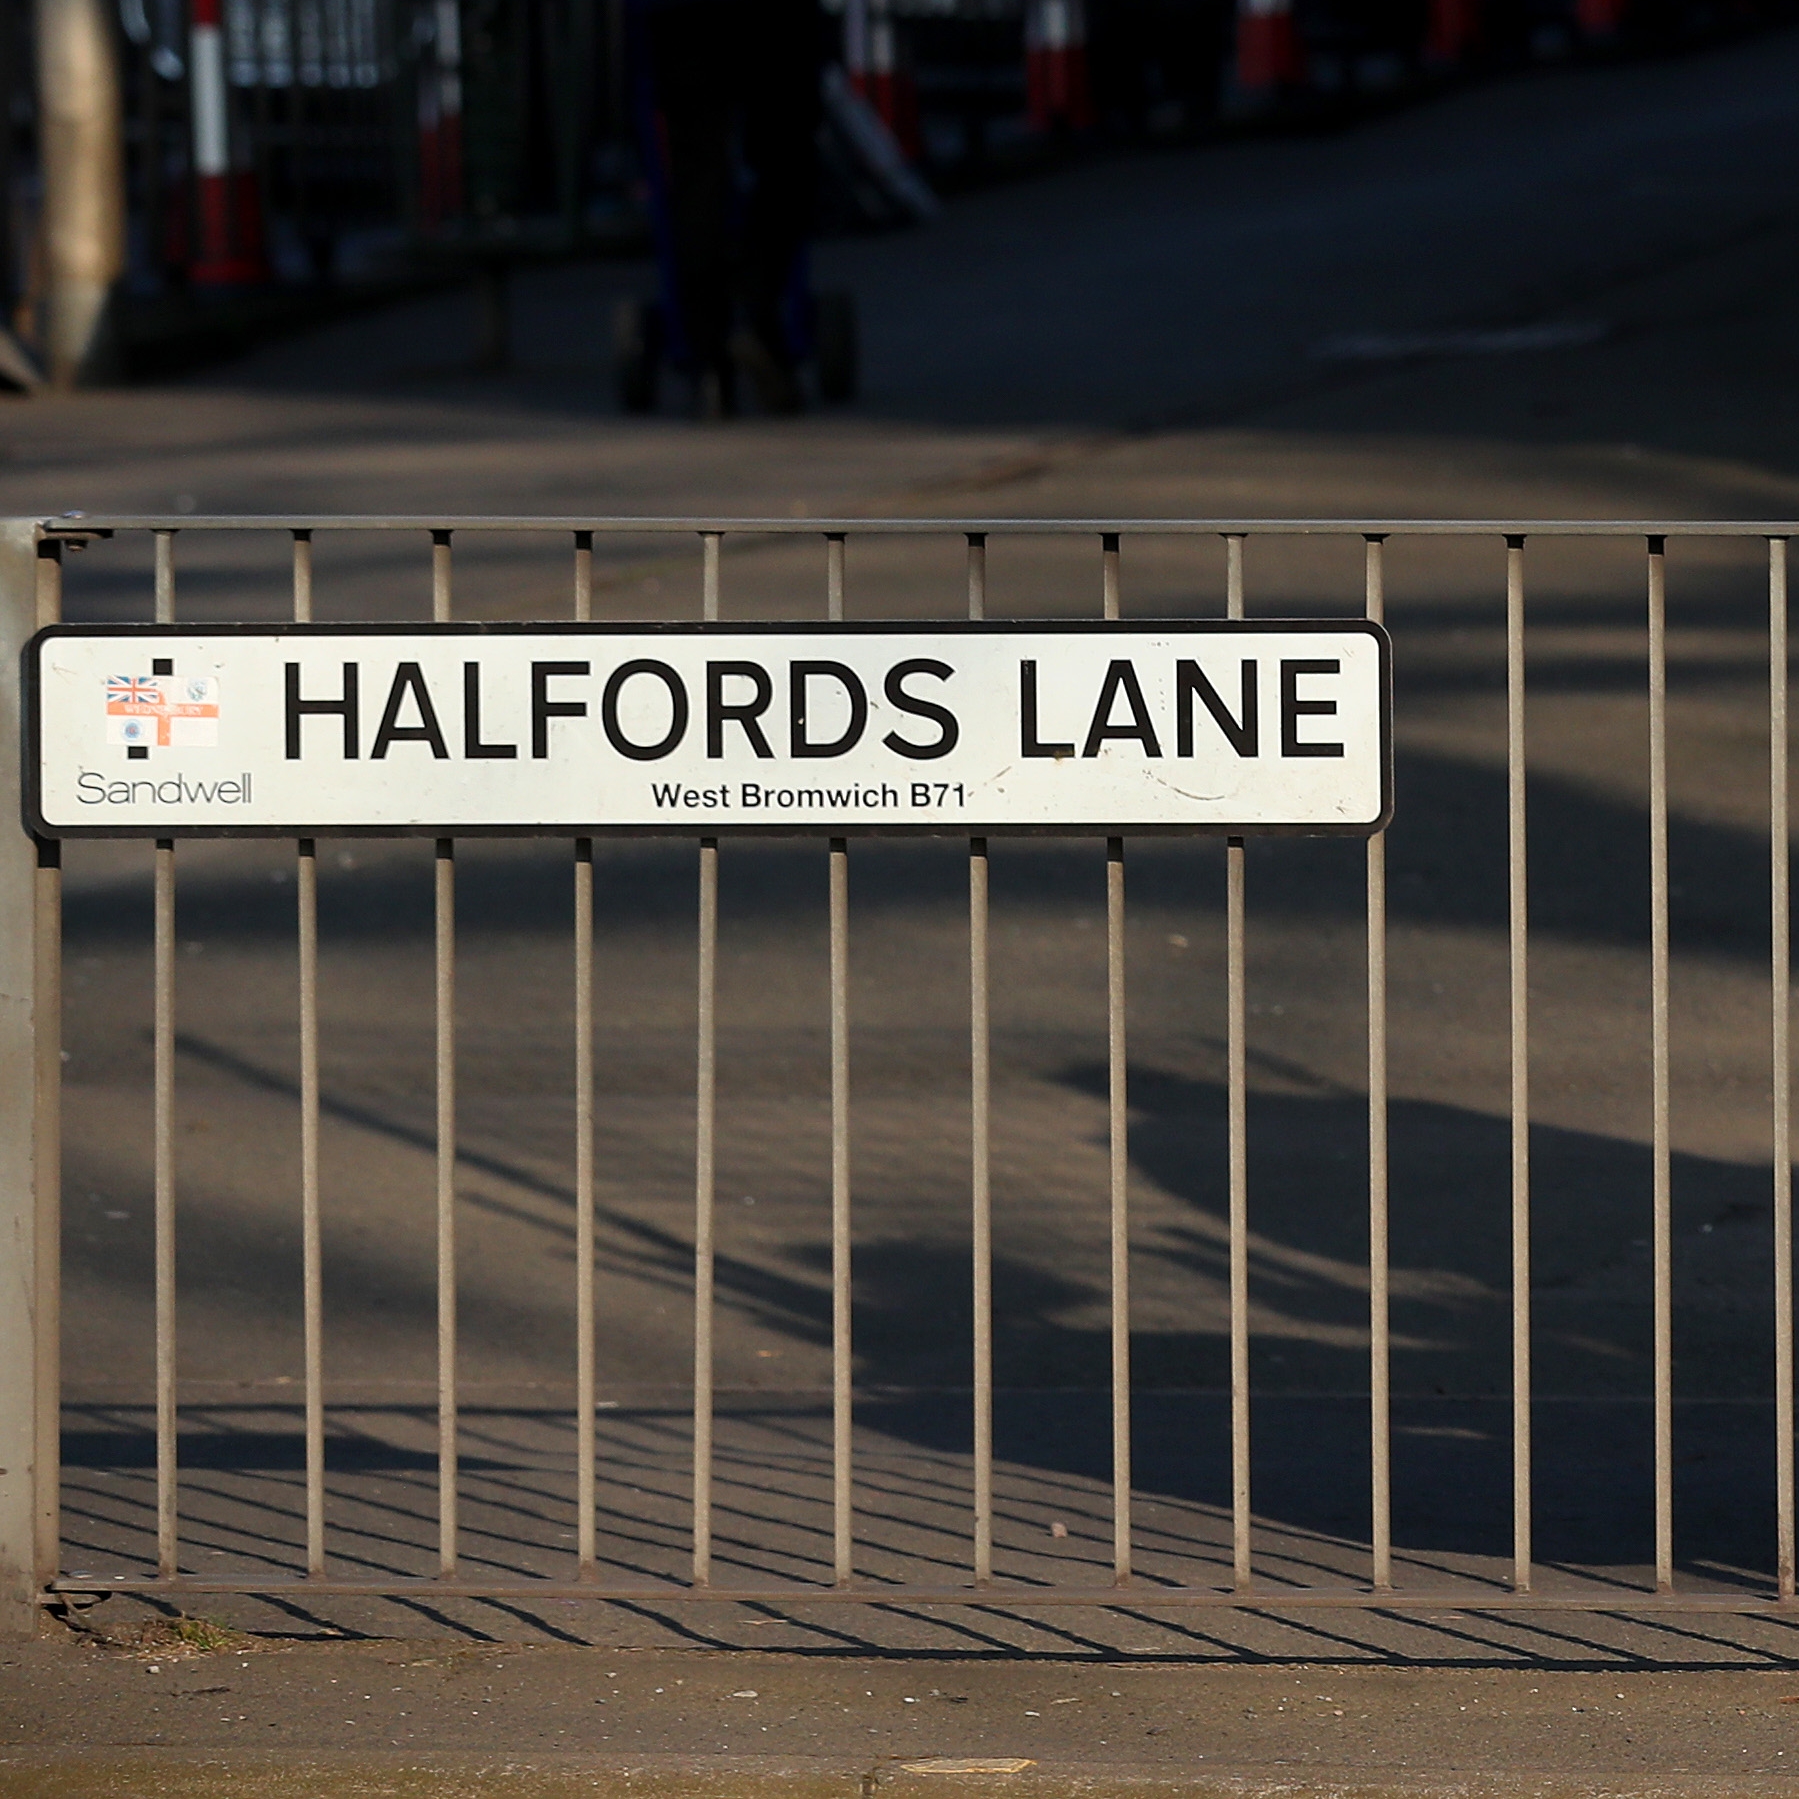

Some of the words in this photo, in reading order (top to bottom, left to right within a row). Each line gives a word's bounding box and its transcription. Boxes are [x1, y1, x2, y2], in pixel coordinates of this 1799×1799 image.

[283, 657, 960, 763] HALFORDS
[1021, 658, 1344, 761] LANE
[76, 772, 252, 804] Sandwell
[651, 782, 730, 808] West
[741, 782, 898, 808] Bromwich
[910, 782, 966, 808] B71
